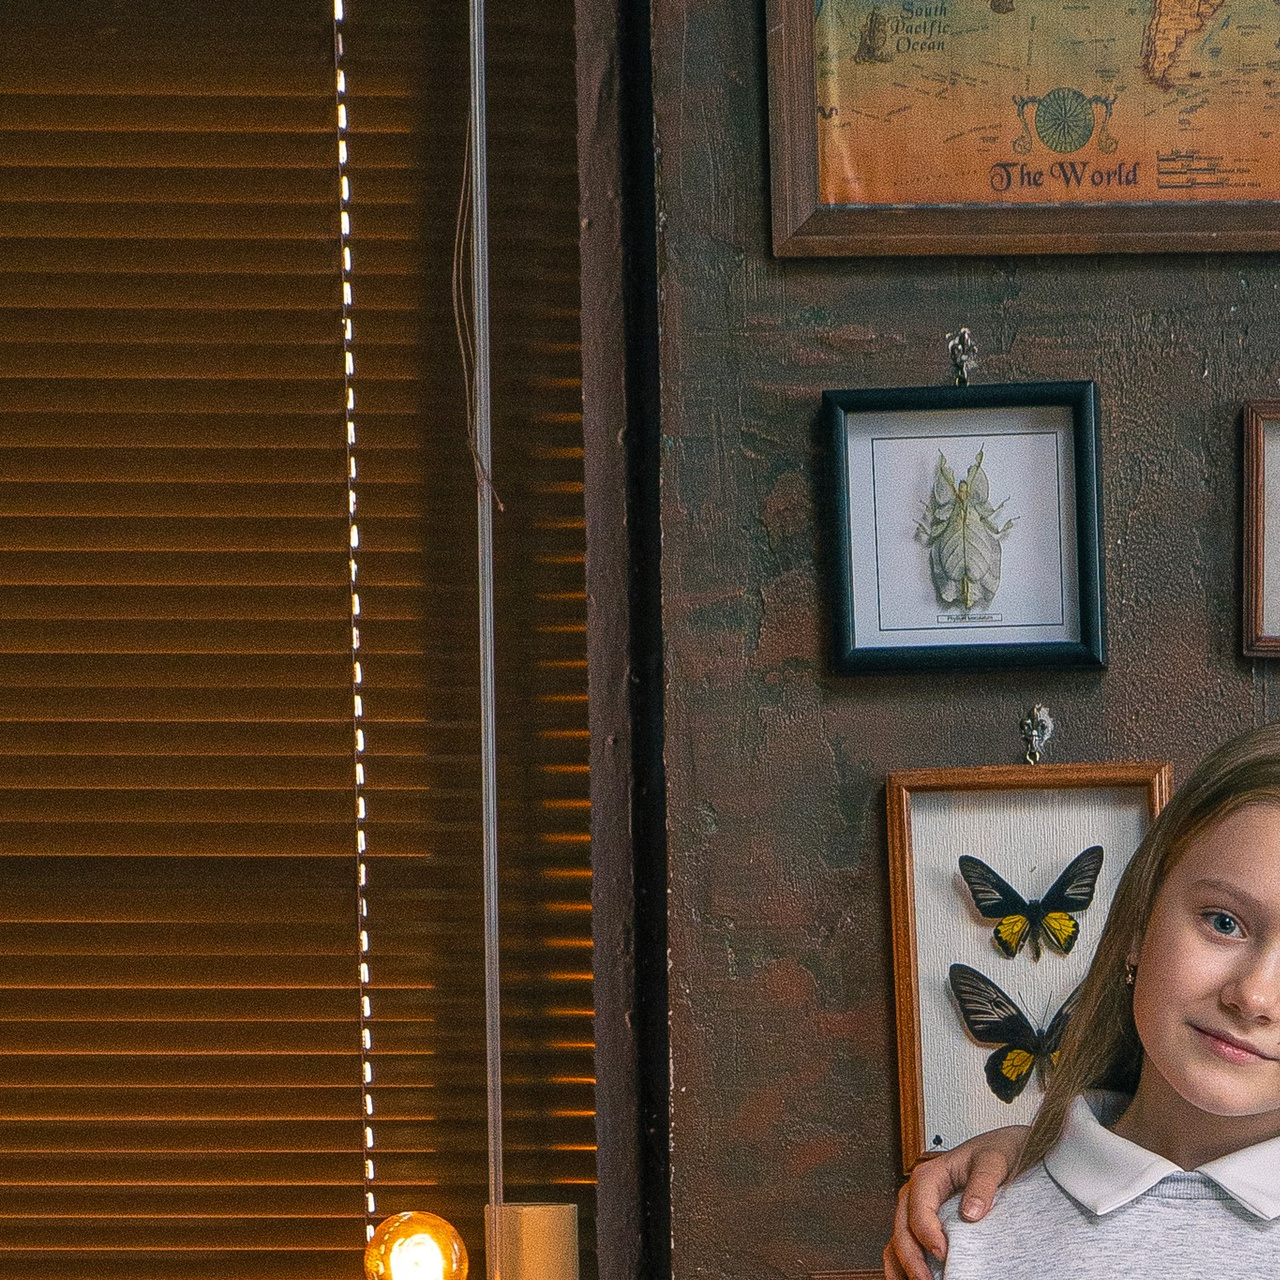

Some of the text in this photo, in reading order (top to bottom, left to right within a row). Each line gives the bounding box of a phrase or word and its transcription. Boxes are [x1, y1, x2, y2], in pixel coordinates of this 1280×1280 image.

[896, 37, 946, 51] Ocean
[989, 162, 1044, 192] The
[1050, 161, 1141, 189] World
